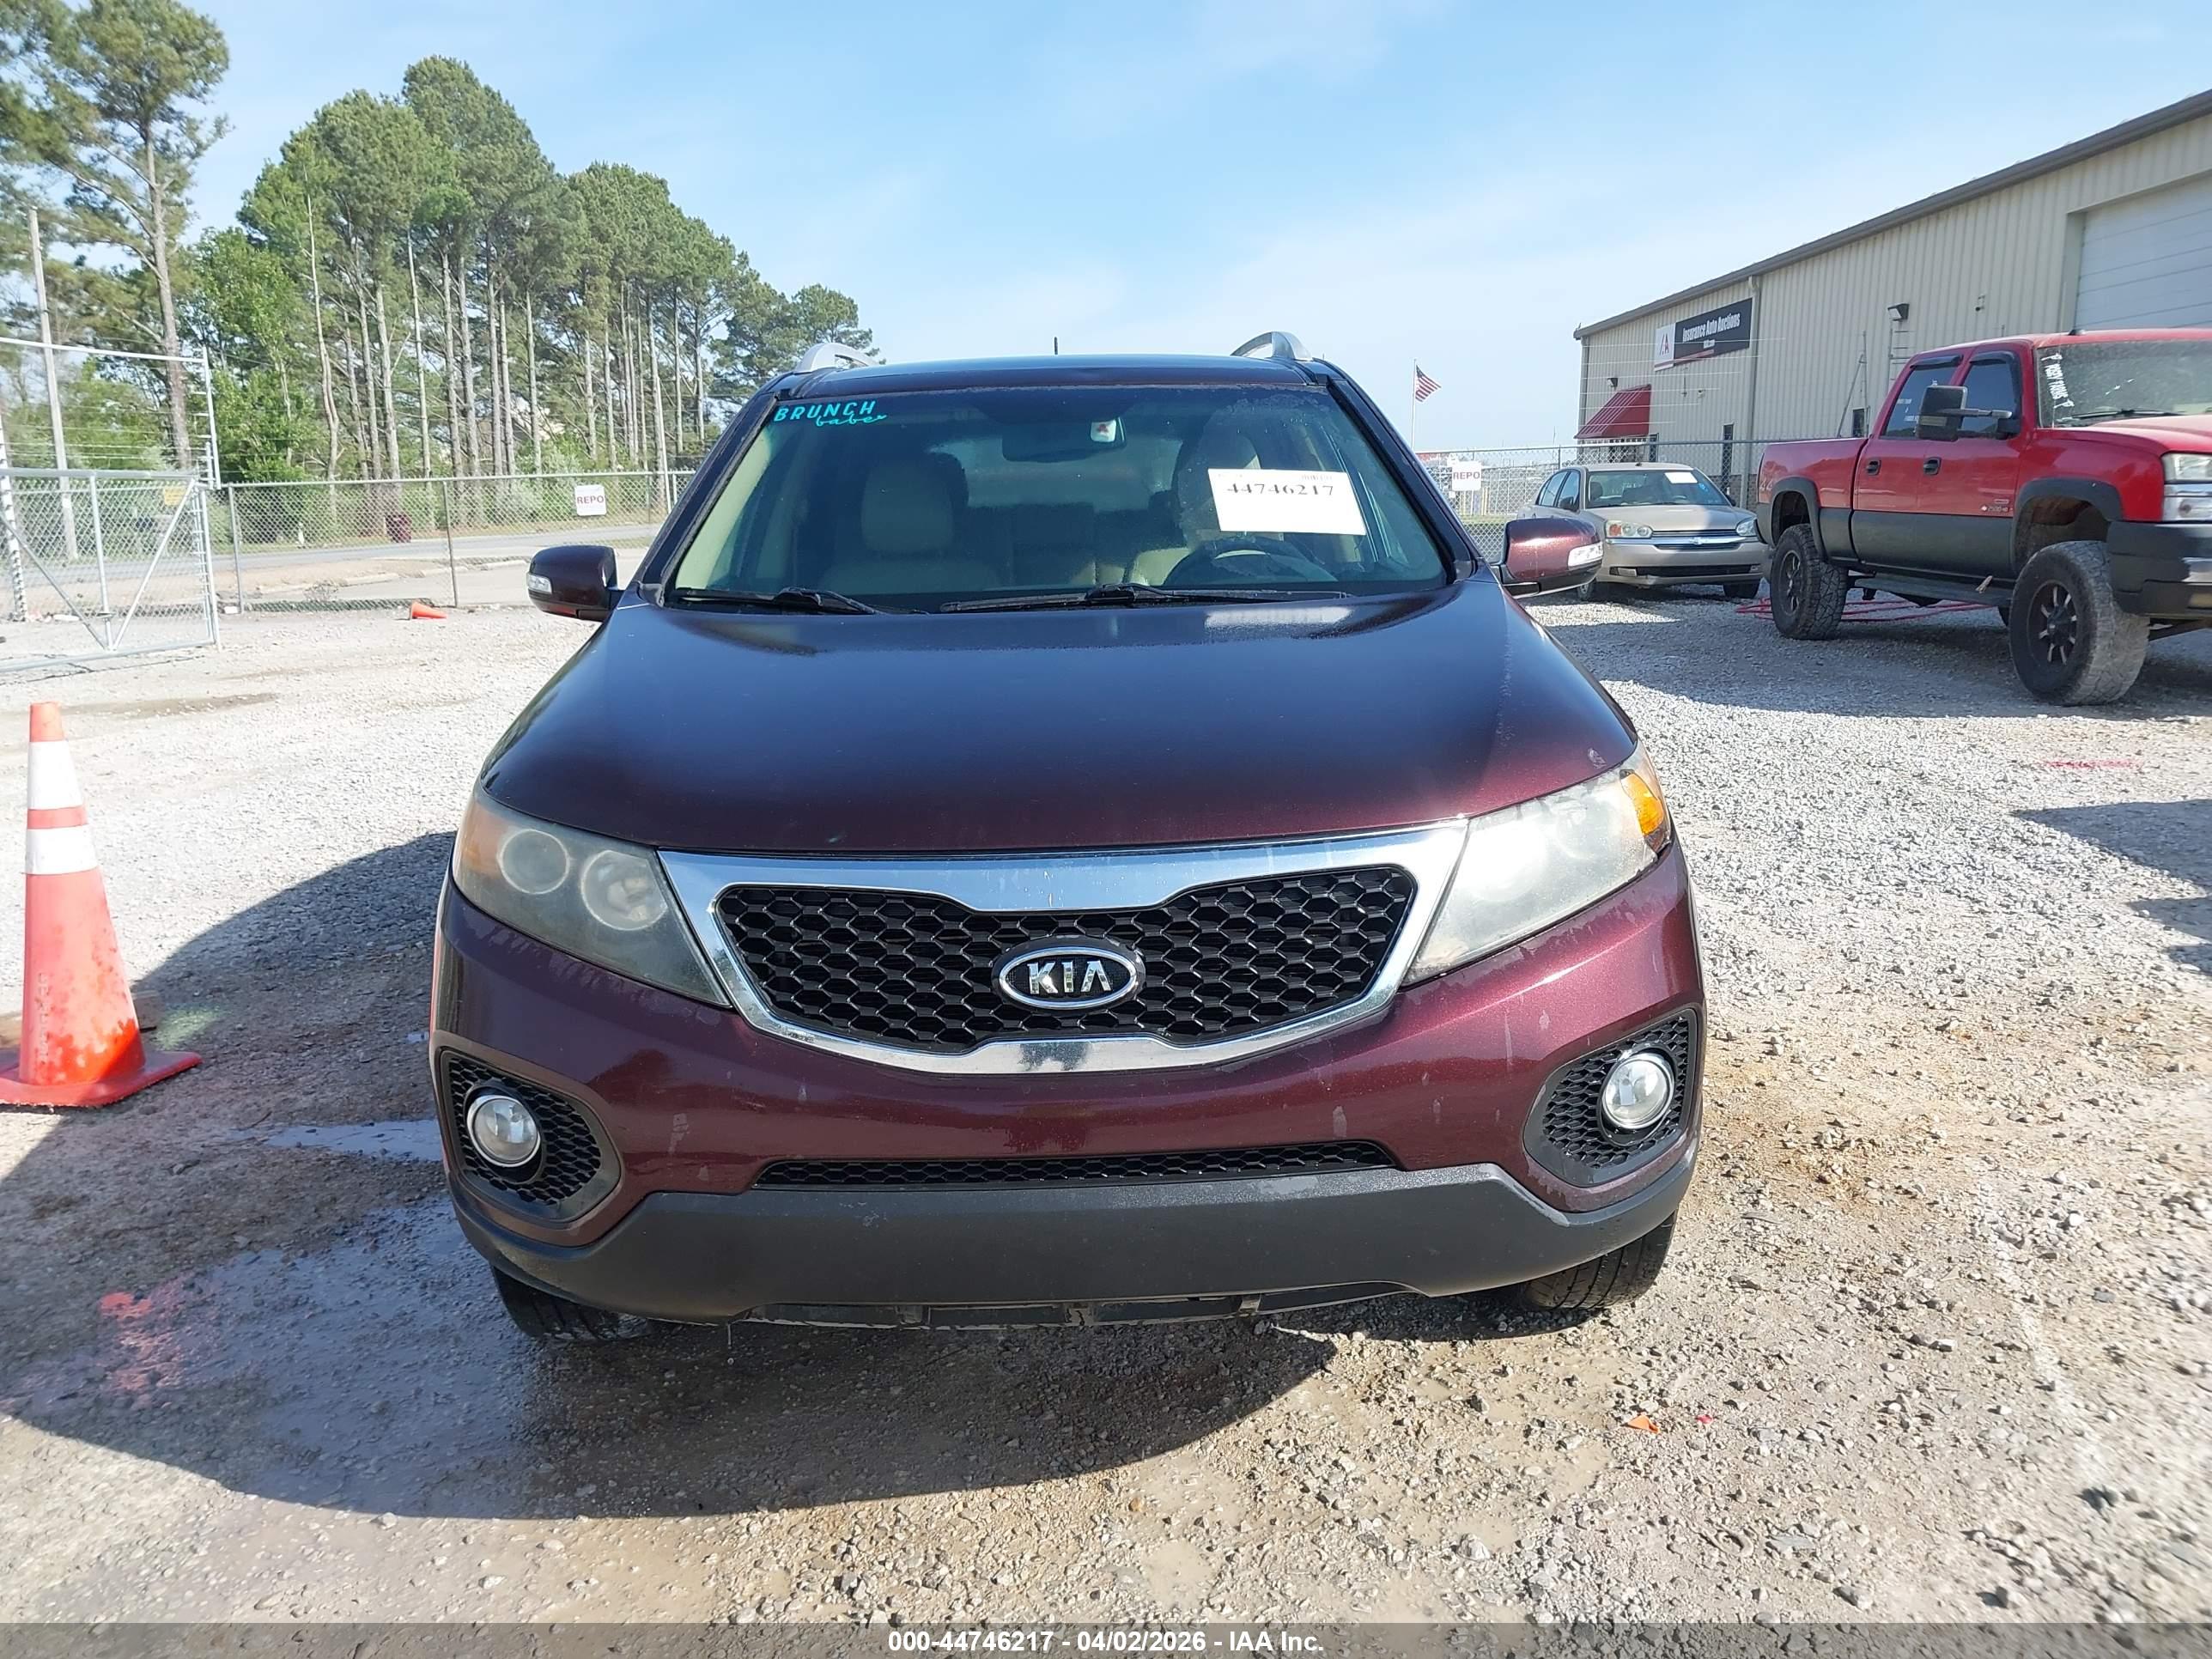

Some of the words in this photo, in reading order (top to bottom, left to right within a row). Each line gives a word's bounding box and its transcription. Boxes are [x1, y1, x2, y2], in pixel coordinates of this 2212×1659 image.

[1683, 324, 1706, 343] Insurance
[1706, 319, 1717, 336] Auto
[1717, 313, 1741, 332] Auctions
[774, 400, 876, 422] BRUNCH
[1452, 471, 1480, 480] REPO
[1227, 483, 1334, 495] 44746217
[577, 495, 605, 504] REPO
[1027, 960, 1111, 994] KIA
